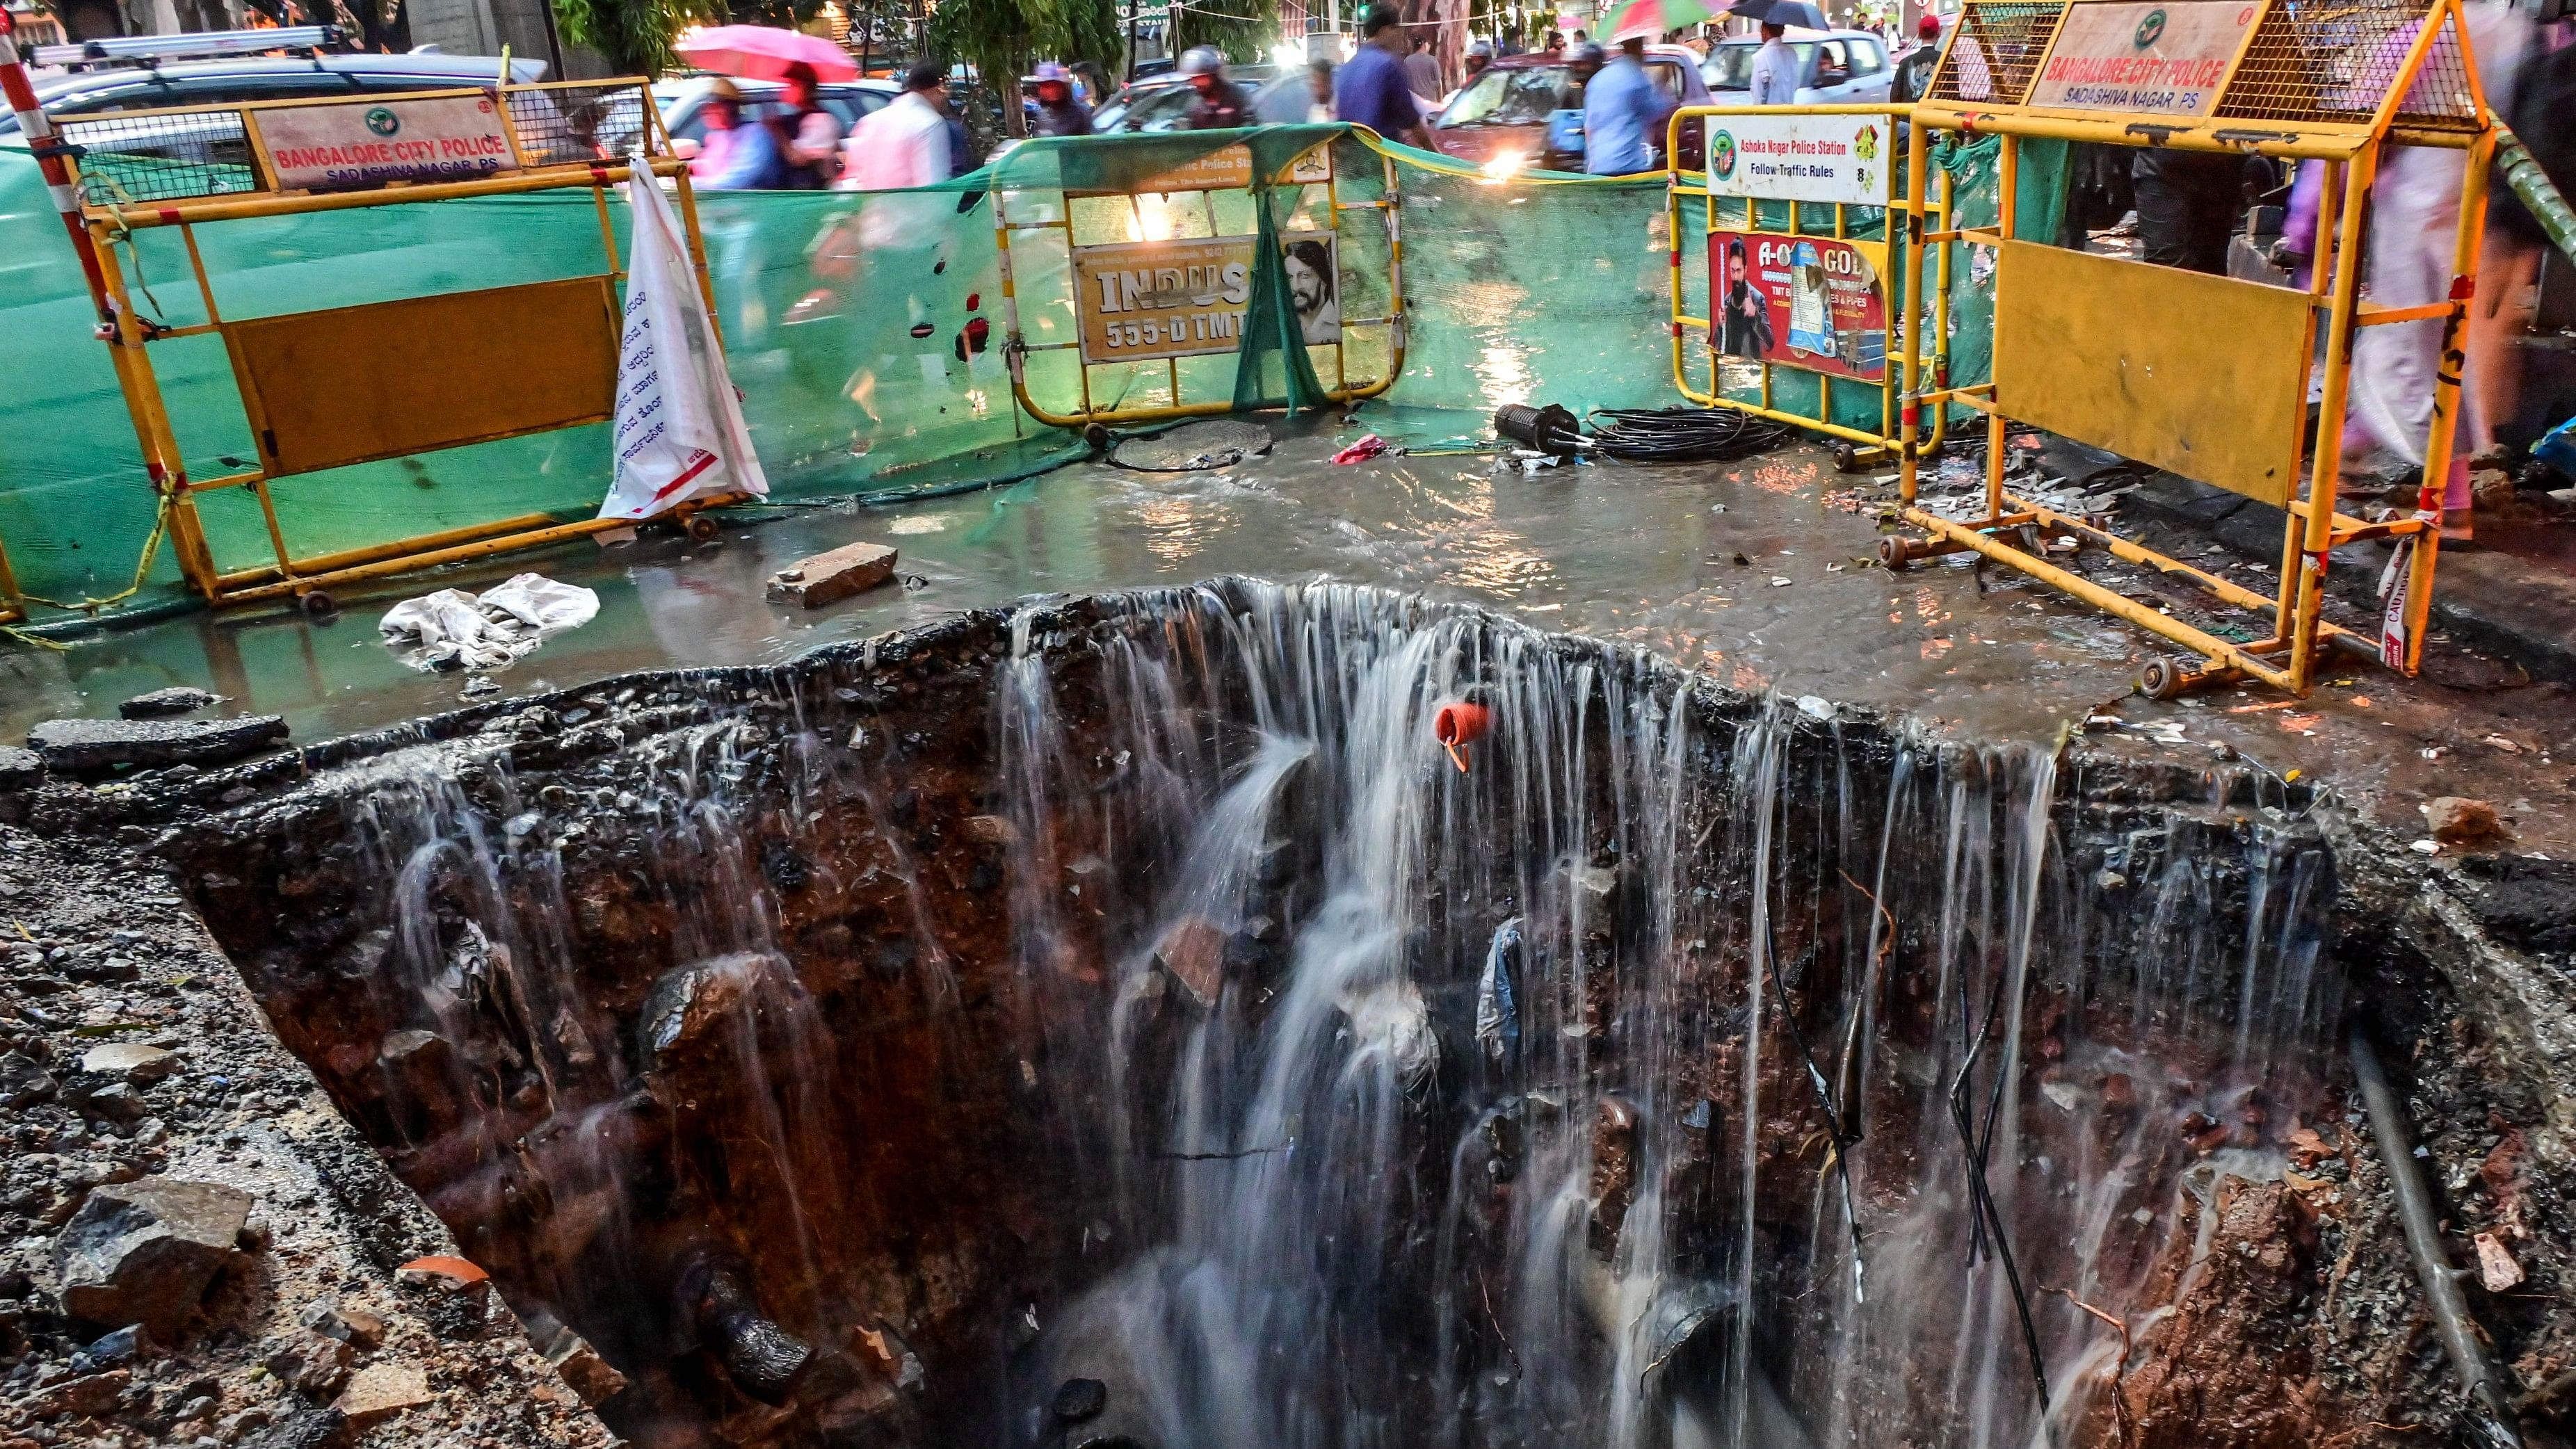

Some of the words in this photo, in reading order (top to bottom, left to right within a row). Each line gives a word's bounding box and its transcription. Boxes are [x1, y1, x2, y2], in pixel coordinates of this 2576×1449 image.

[2047, 56, 2130, 83] BANGALORE
[2127, 58, 2166, 85] CITY
[2164, 58, 2225, 88] POLICE
[2064, 88, 2127, 105] SADASHIVA
[2130, 91, 2174, 106] NAGAR
[2179, 92, 2199, 108] PS
[276, 144, 392, 169] BANGALORE
[394, 141, 434, 161] CITY
[441, 136, 506, 156] POLICE
[1741, 139, 1766, 153] Ashoka
[1768, 140, 1789, 156] Nagar
[1792, 140, 1816, 154] Police
[1818, 141, 1846, 155] Station
[326, 165, 415, 183] SADASHIVA
[419, 160, 471, 175] NAGAR
[479, 158, 499, 170] PS
[1201, 159, 1233, 169] Police
[1236, 158, 1252, 168] Sta
[1751, 163, 1776, 175] Follow
[1780, 164, 1807, 177] Traffic
[1810, 165, 1834, 177] Rules
[1758, 241, 1791, 267] A-O
[1097, 262, 1250, 313] INDUS
[1771, 286, 1785, 296] TMT
[1785, 289, 1792, 297] B
[1106, 315, 1186, 347] 555-D
[1191, 311, 1246, 340] TMT
